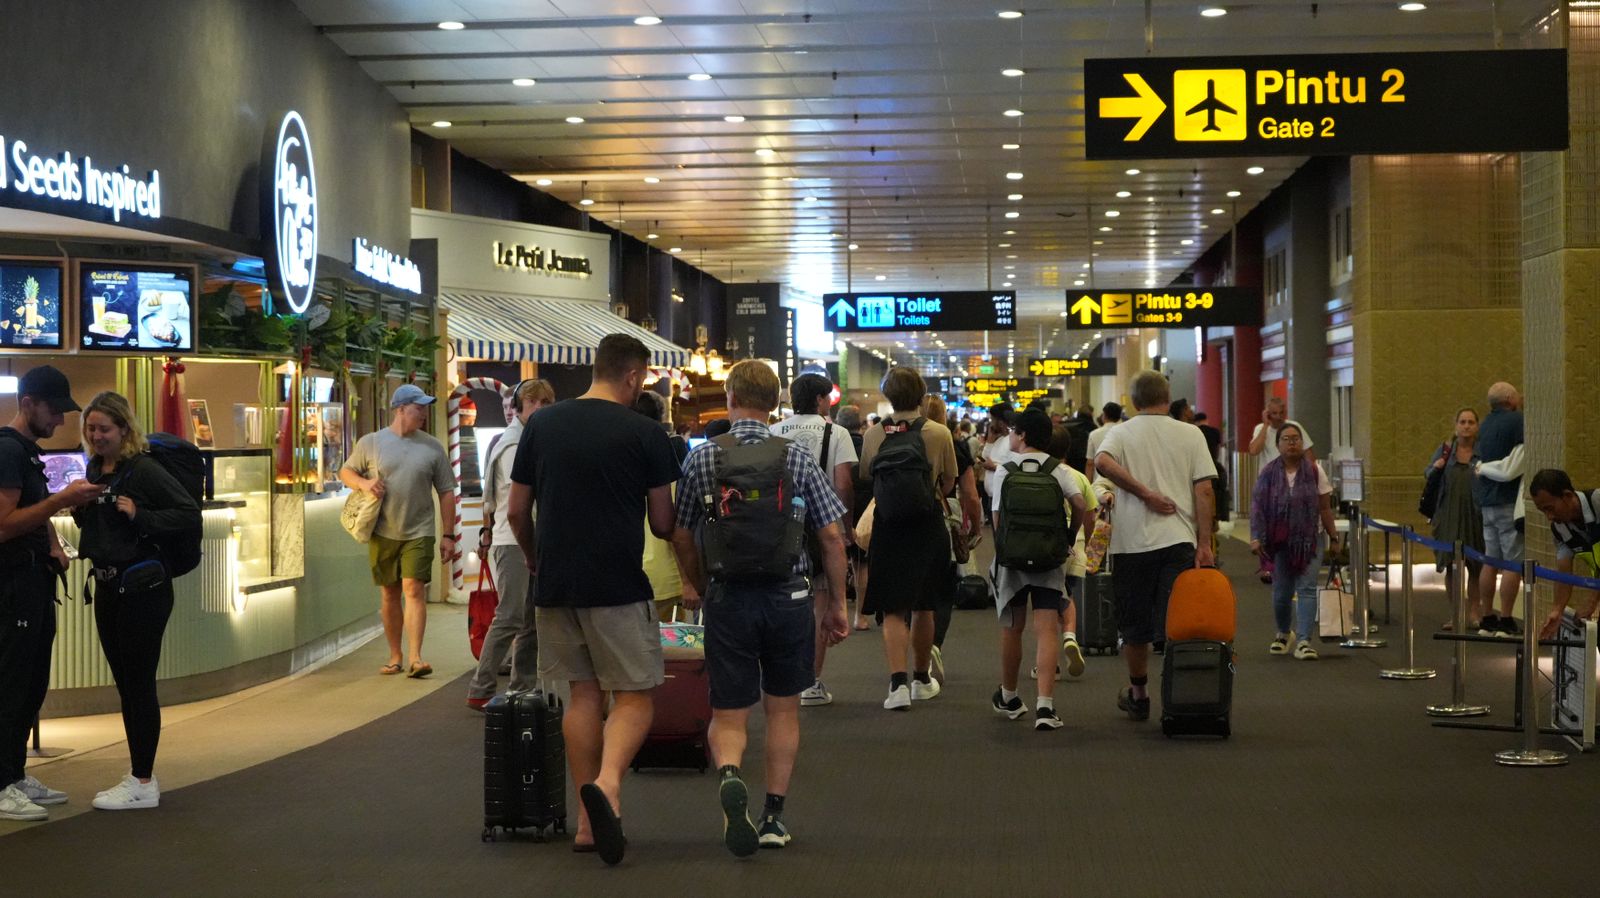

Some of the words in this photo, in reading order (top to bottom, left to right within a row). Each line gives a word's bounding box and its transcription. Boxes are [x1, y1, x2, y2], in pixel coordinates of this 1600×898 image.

[1256, 69, 1366, 105] Pintu
[1381, 68, 1405, 103] 2
[1258, 117, 1314, 139] Gate
[1320, 117, 1335, 137] 2
[13, 140, 82, 201] Seeds
[85, 156, 161, 222] Inspired
[498, 242, 513, 266] Le
[516, 245, 545, 271] Petit
[896, 297, 942, 313] Toilet
[1136, 293, 1182, 309] Pintu
[1185, 292, 1214, 309] 3-9
[897, 315, 931, 326] Toilets
[1136, 312, 1165, 323] Gates
[1165, 312, 1183, 323] 3-9
[781, 424, 826, 434] BRIGHTO
